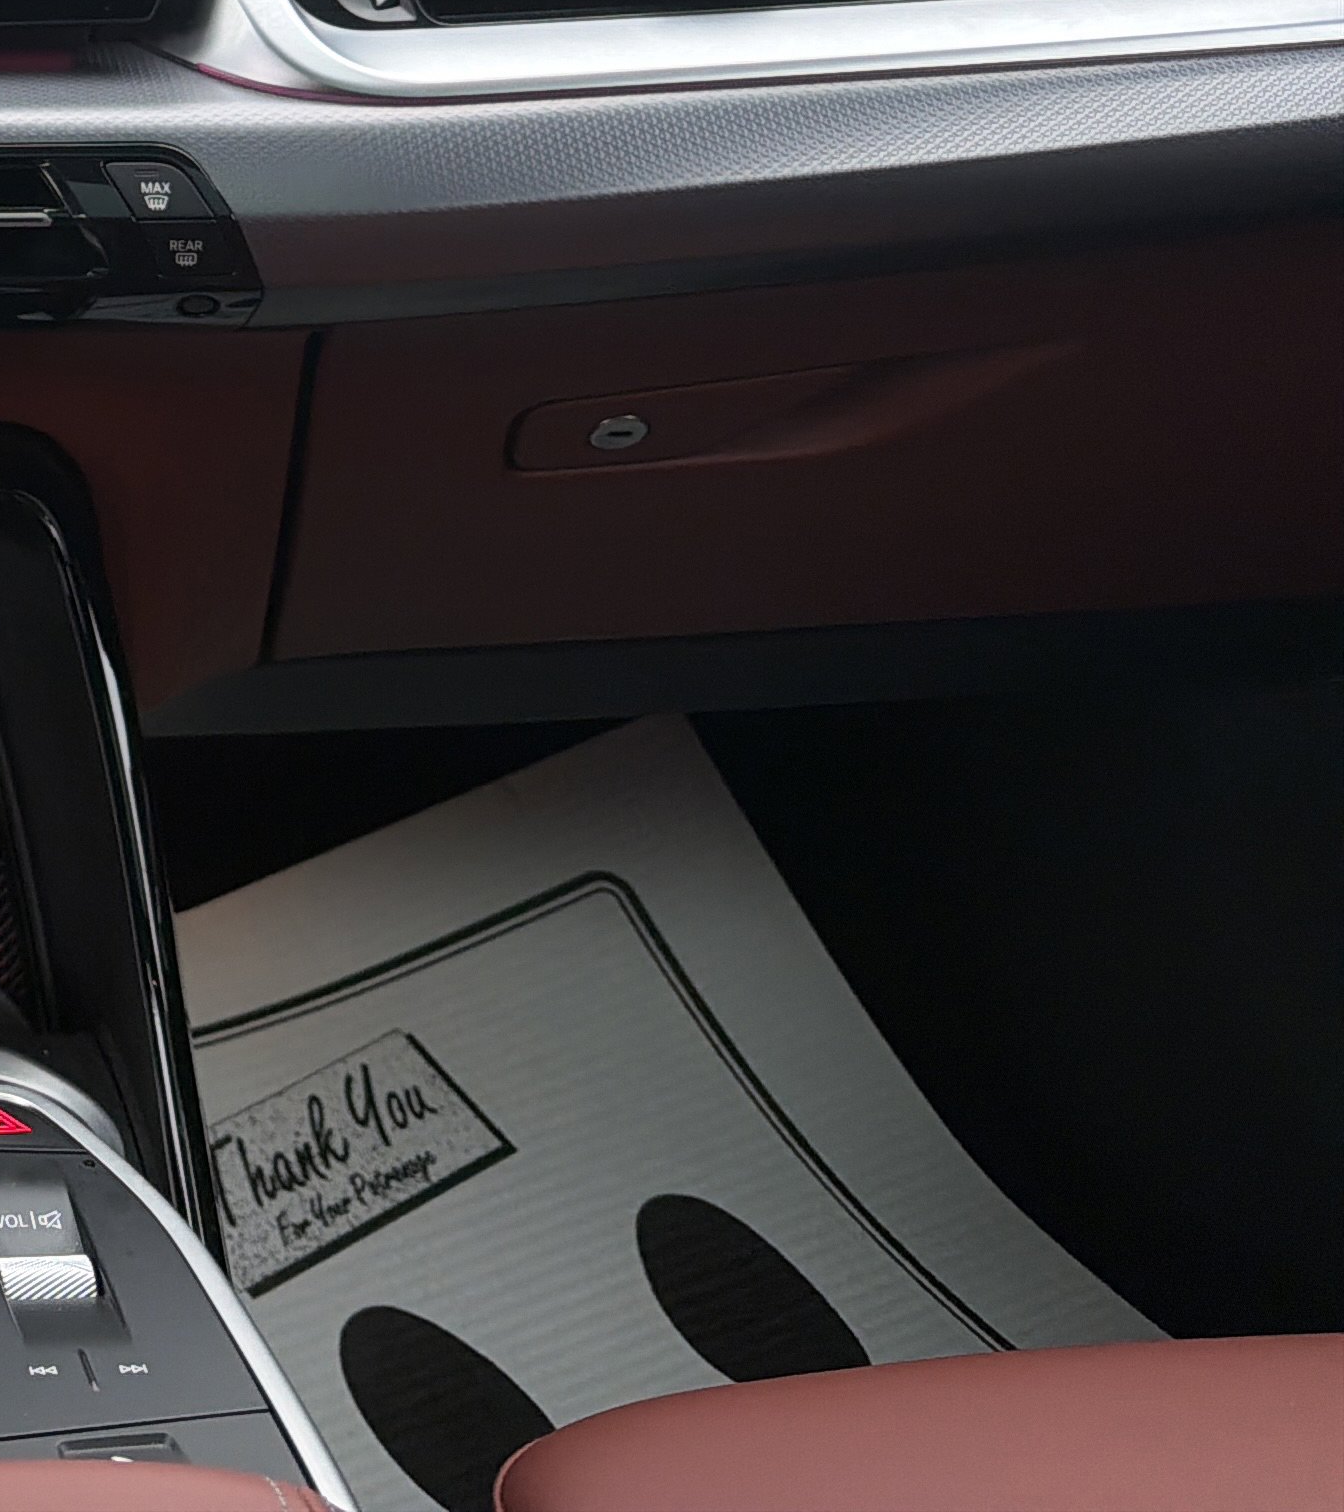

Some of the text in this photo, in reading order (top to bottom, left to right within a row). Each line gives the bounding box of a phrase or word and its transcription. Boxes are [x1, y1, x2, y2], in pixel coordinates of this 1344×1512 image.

[140, 181, 172, 194] MAX
[169, 239, 204, 252] REAR
[212, 1063, 439, 1228] Thank You
[309, 1192, 352, 1229] Your
